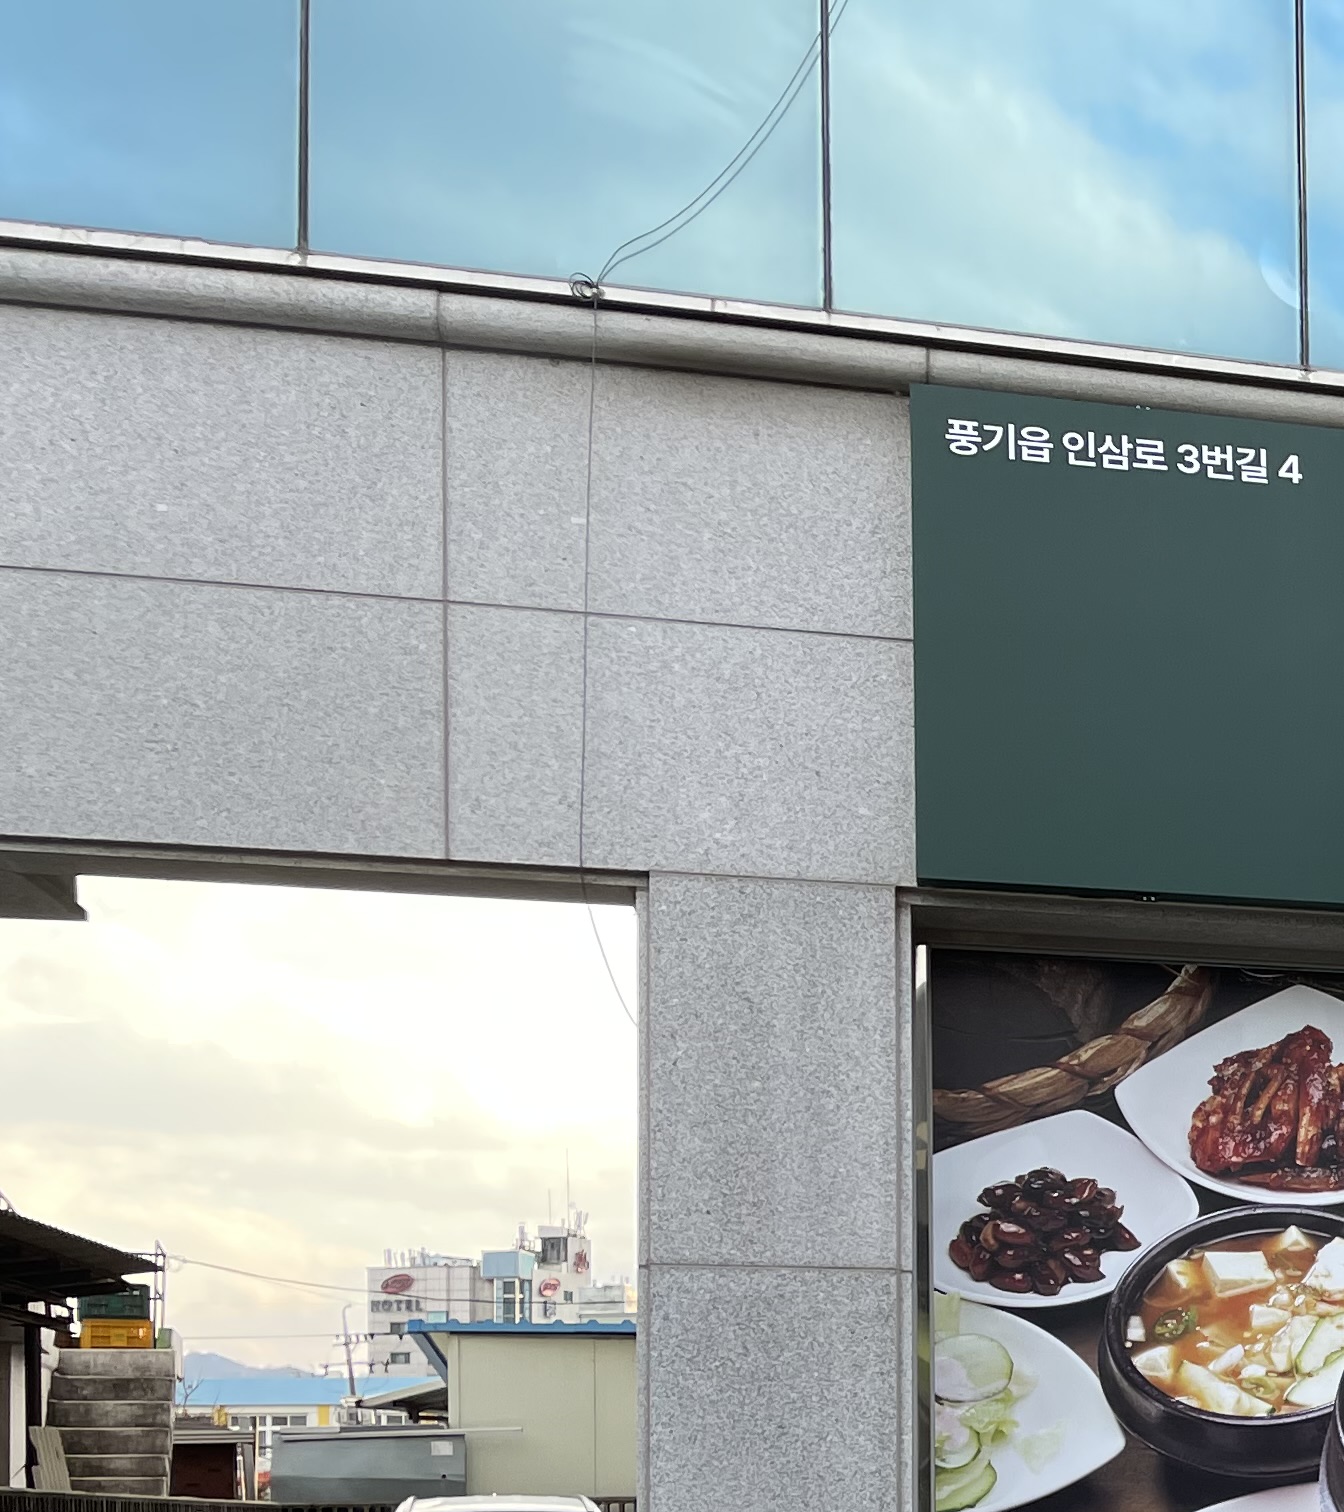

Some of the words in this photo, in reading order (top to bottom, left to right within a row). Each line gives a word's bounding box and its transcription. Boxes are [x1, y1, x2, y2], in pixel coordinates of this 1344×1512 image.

[945, 418, 1054, 463] 풍기읍
[1062, 431, 1169, 471] 인삼로
[1176, 444, 1269, 484] 3번길
[1278, 454, 1303, 484] 4
